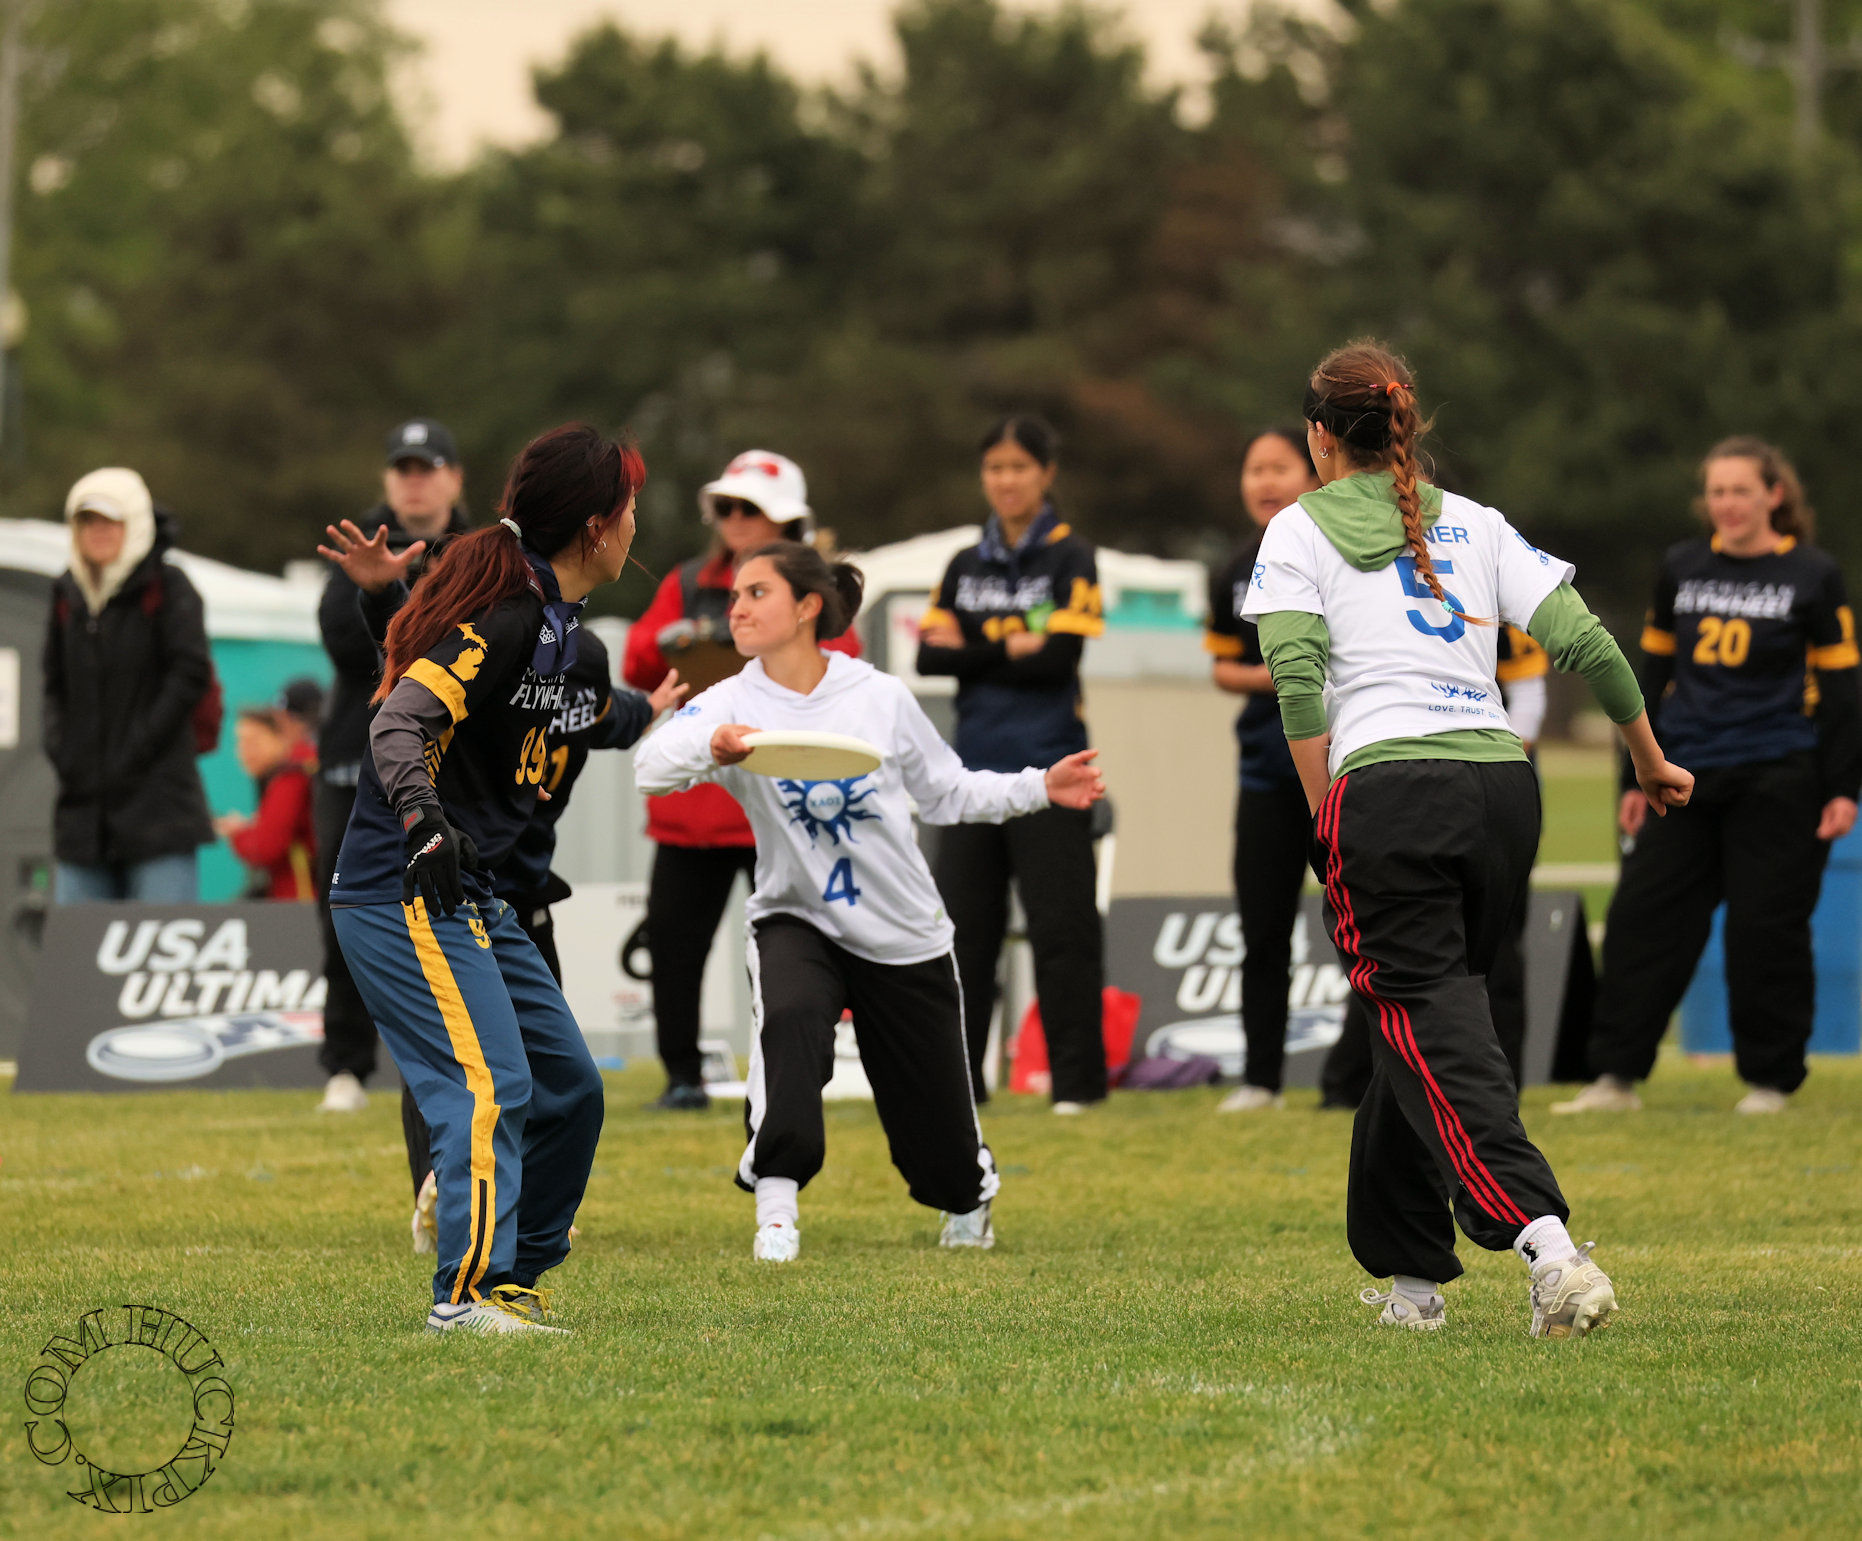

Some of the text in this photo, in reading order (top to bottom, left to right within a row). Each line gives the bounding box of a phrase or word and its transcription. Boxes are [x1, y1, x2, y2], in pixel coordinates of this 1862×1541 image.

[1394, 556, 1465, 643] 5
[1692, 616, 1751, 668] 20
[515, 727, 546, 784] 99
[822, 857, 861, 906] 4
[97, 918, 248, 975] USA
